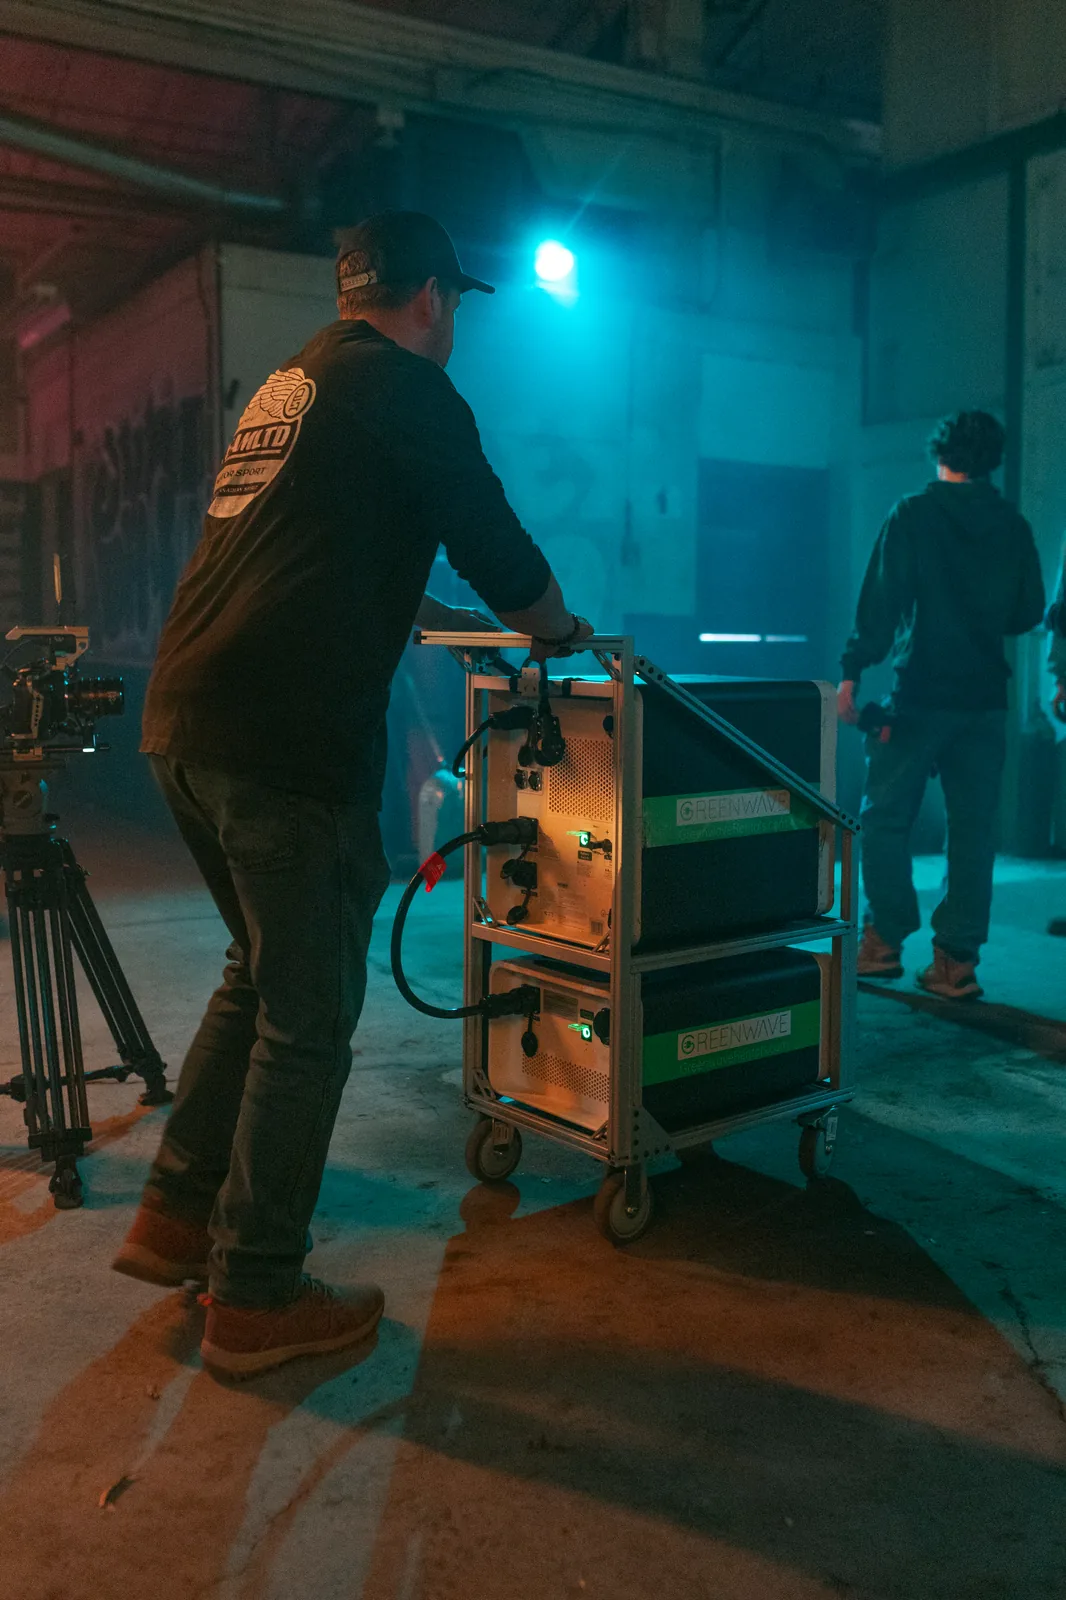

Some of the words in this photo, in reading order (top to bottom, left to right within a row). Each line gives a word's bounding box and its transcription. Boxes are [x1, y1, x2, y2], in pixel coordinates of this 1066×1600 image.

[236, 466, 266, 477] SPORT
[680, 792, 787, 821] GREENWAVE
[681, 1013, 788, 1055] GREENWAVE
